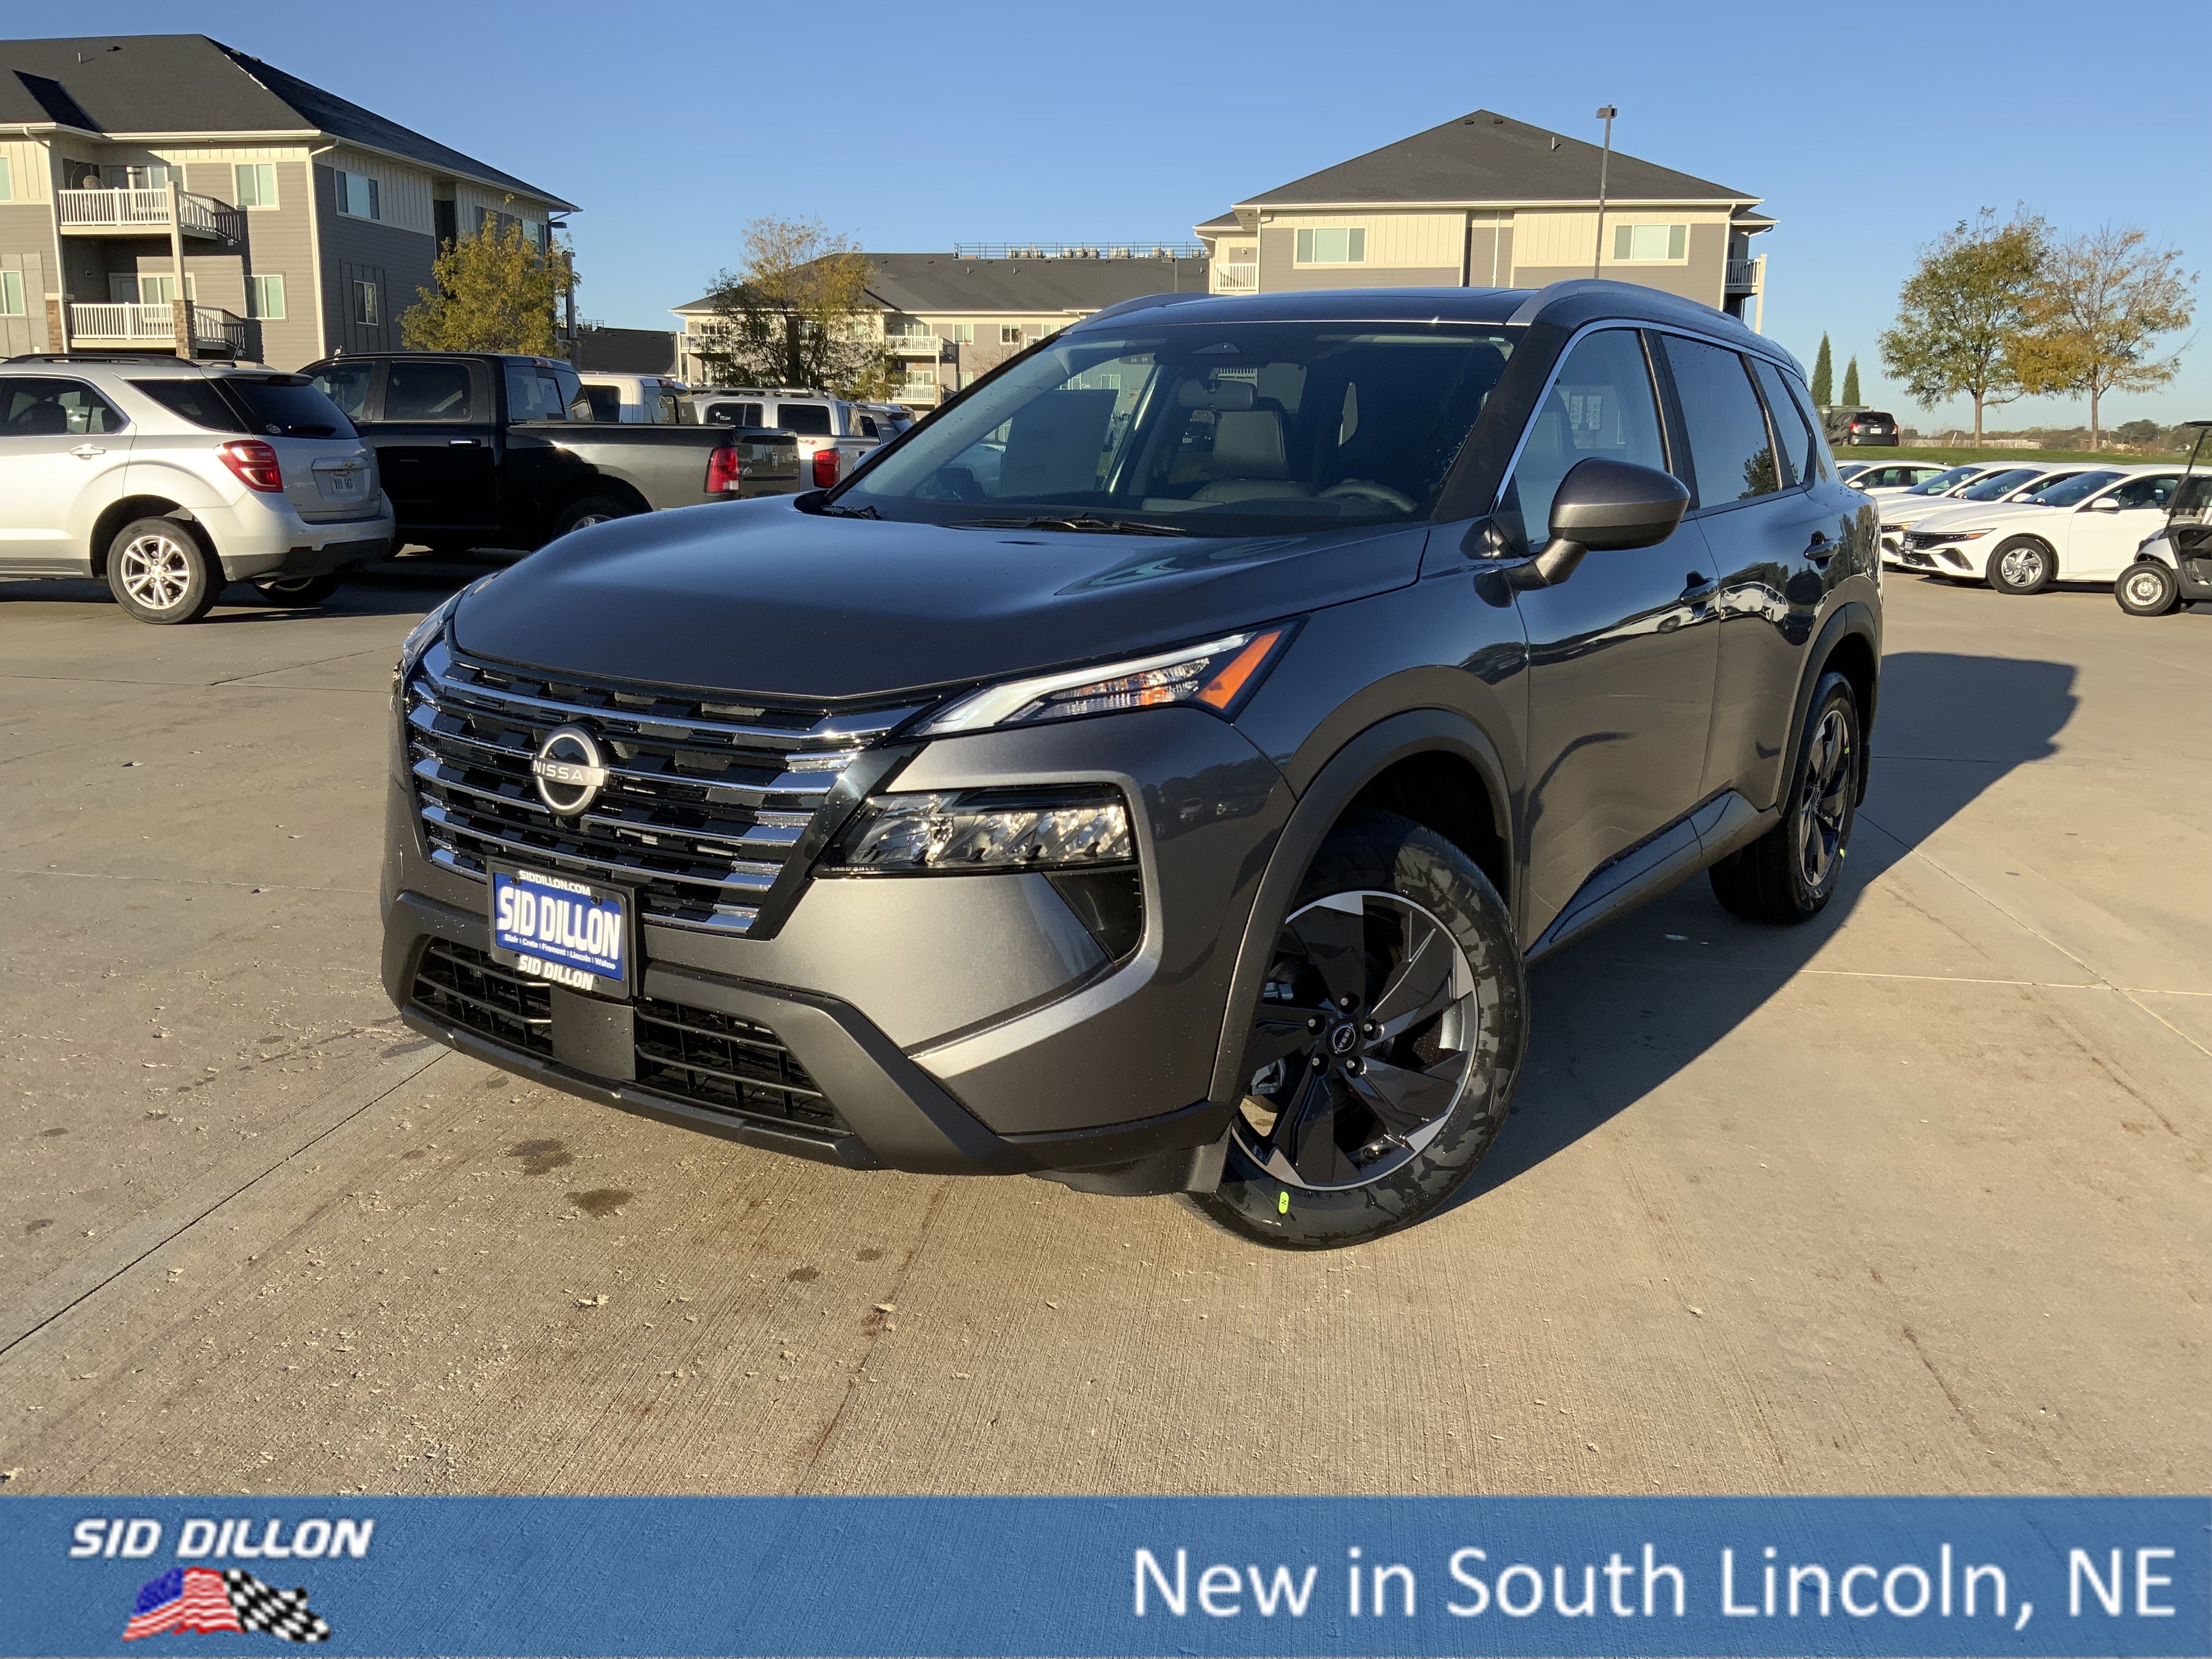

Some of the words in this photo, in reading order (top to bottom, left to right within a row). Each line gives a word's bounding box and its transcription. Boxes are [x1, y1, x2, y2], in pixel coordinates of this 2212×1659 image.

[533, 759, 601, 783] NISSAN
[519, 870, 591, 896] SIDDILLON.COM
[498, 885, 536, 937] SID
[540, 895, 621, 961] DILLON
[504, 934, 518, 944] Blair
[523, 938, 538, 949] Crete
[542, 943, 566, 956] Fremont
[570, 950, 591, 963] Lincoln
[595, 957, 616, 970] Wahoo
[518, 954, 541, 975] SID
[544, 962, 594, 991] DILLON
